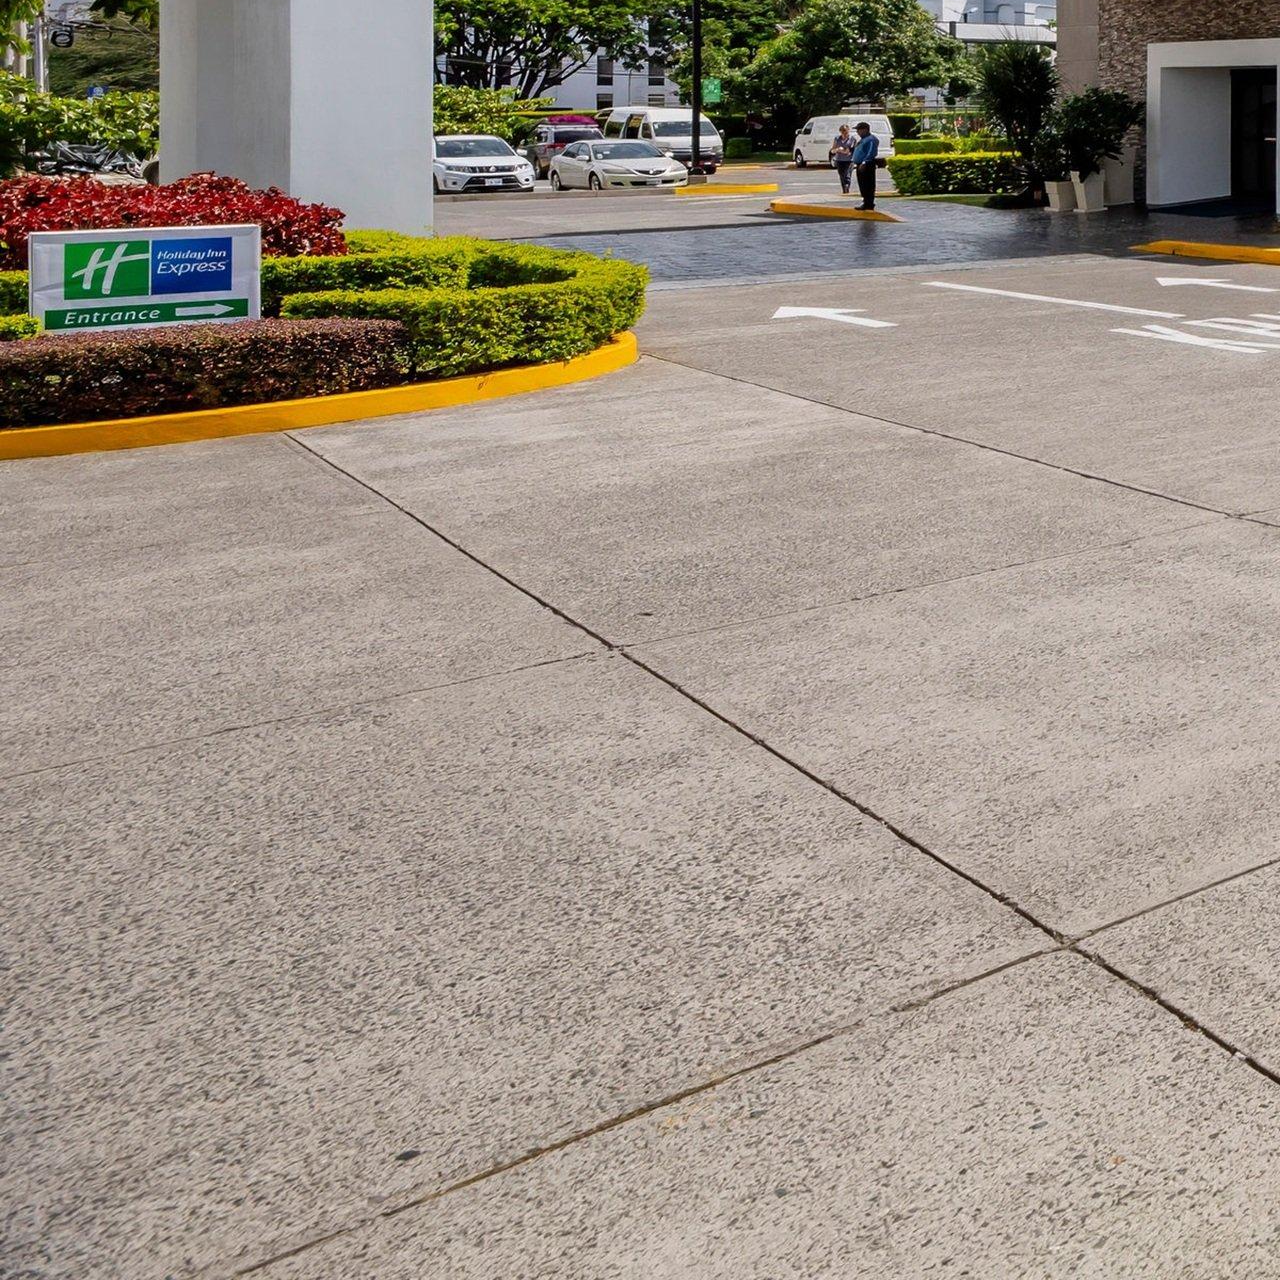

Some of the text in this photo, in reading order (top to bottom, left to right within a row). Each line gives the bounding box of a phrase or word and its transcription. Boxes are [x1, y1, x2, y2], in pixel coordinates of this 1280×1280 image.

[157, 249, 227, 261] Holiday Inn
[157, 261, 227, 276] Express
[64, 308, 161, 326] Entrance
